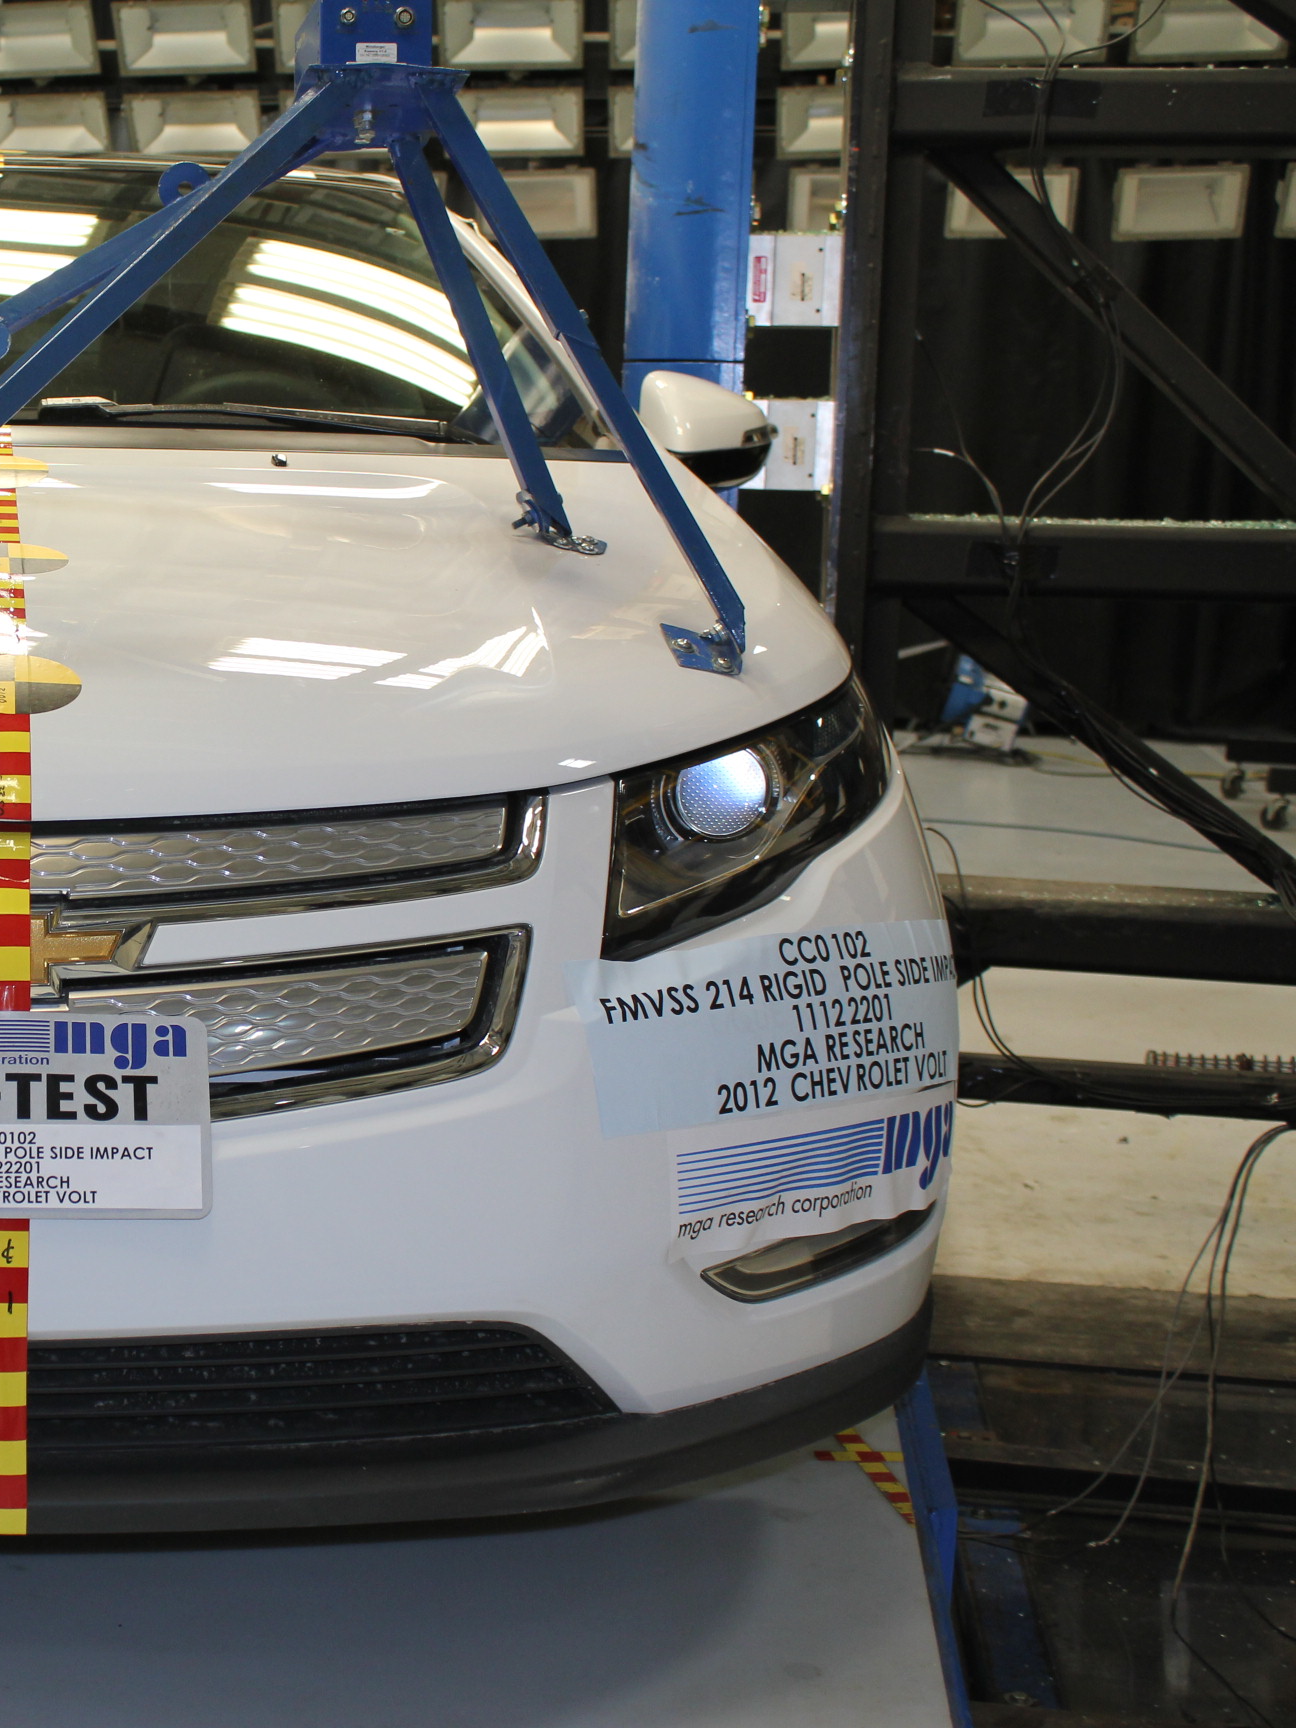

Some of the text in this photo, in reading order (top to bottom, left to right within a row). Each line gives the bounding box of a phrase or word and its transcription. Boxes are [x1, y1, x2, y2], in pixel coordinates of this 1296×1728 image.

[778, 930, 872, 966] CC0102
[599, 983, 700, 1024] FMVSS
[705, 976, 754, 1010] 214
[759, 968, 827, 1002] RIGID
[839, 961, 892, 992] POLE
[896, 958, 930, 987] SIDE
[54, 1021, 187, 1070] mga
[756, 1021, 926, 1073] MGA RESEARCH
[717, 1051, 948, 1115] 2012 CHEVROLET VOLT
[4, 1147, 46, 1160] POLE
[50, 1147, 85, 1160] SIDE
[89, 1147, 154, 1161] IMPACT
[54, 1190, 98, 1204] VOLT
[678, 1182, 872, 1240] mga research corporation
